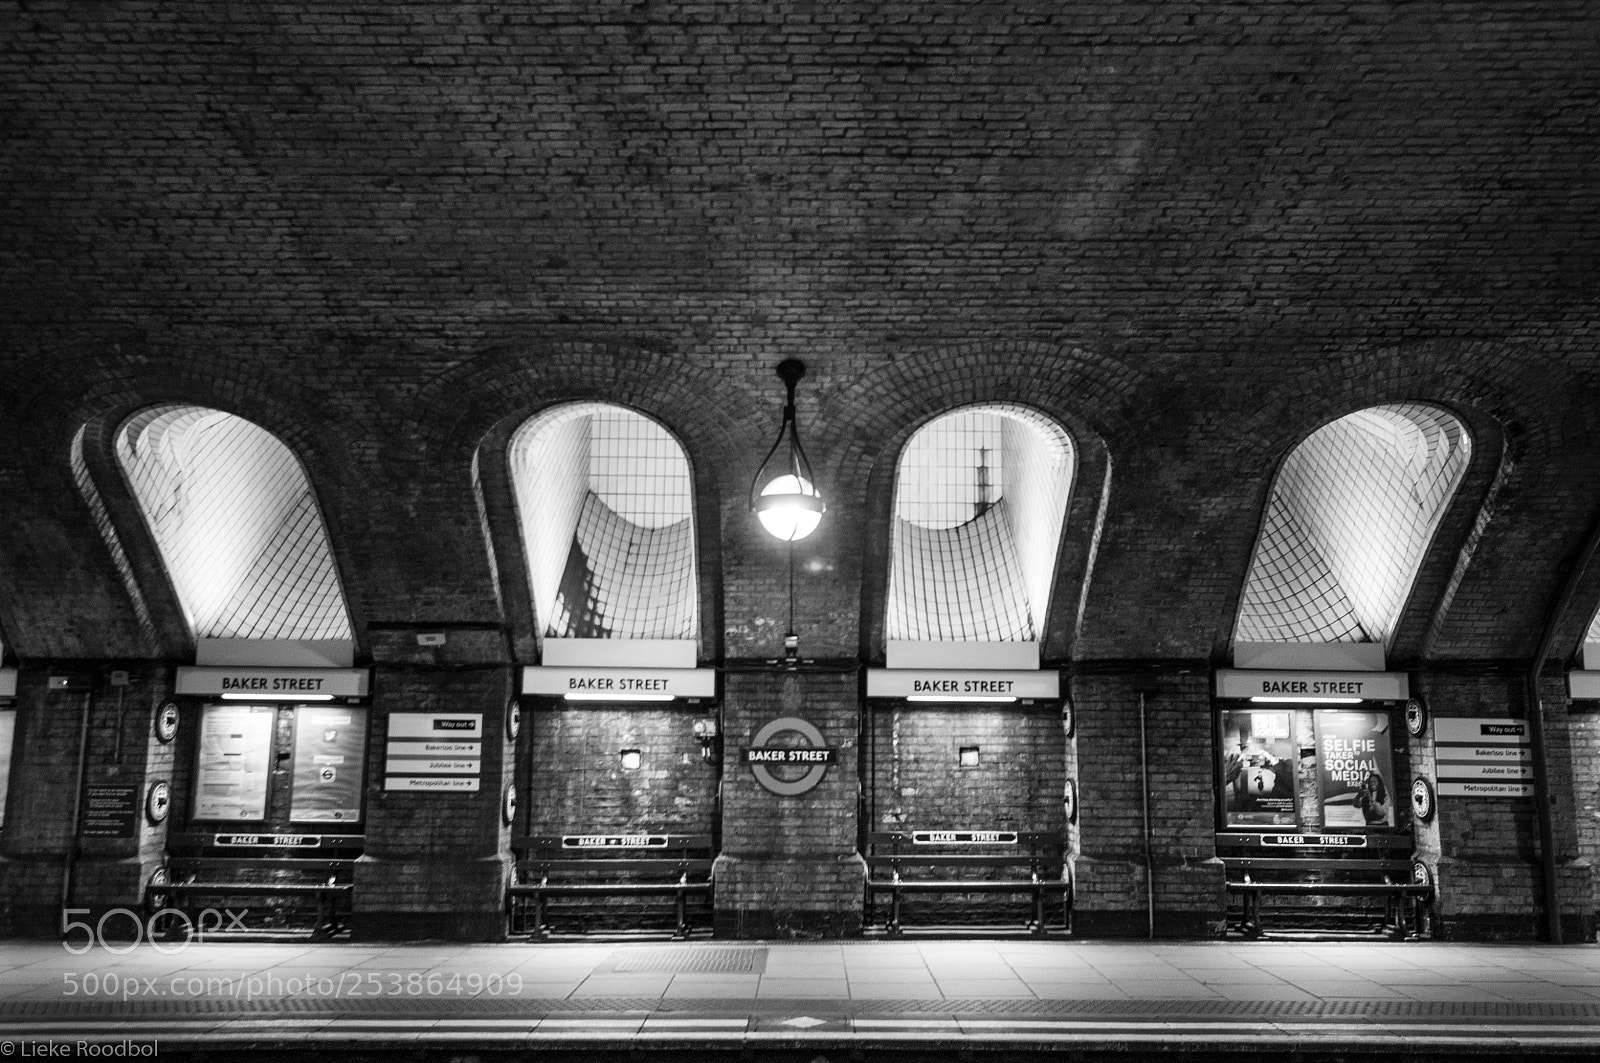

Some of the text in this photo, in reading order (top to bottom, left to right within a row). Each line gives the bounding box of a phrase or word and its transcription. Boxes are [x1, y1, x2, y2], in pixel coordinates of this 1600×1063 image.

[222, 677, 325, 690] BAKER STREET
[569, 678, 669, 690] BAKER STREET
[914, 680, 1014, 693] BAKER STREET
[1262, 681, 1363, 694] BAKER STREET
[441, 720, 455, 729] Way
[1488, 725, 1503, 734] Way
[1323, 739, 1376, 753] SELFIE
[748, 750, 830, 761] BAKER STREET
[1324, 751, 1354, 760] TAKER
[1324, 759, 1376, 771] SOCIAL
[1331, 770, 1371, 782] MEDIA
[1463, 784, 1507, 793] Metropolitan
[274, 836, 303, 845] STREET
[578, 837, 650, 846] BAKER STREET
[929, 833, 1000, 842] BAKER STREET
[1277, 836, 1348, 845] BAKER STREET
